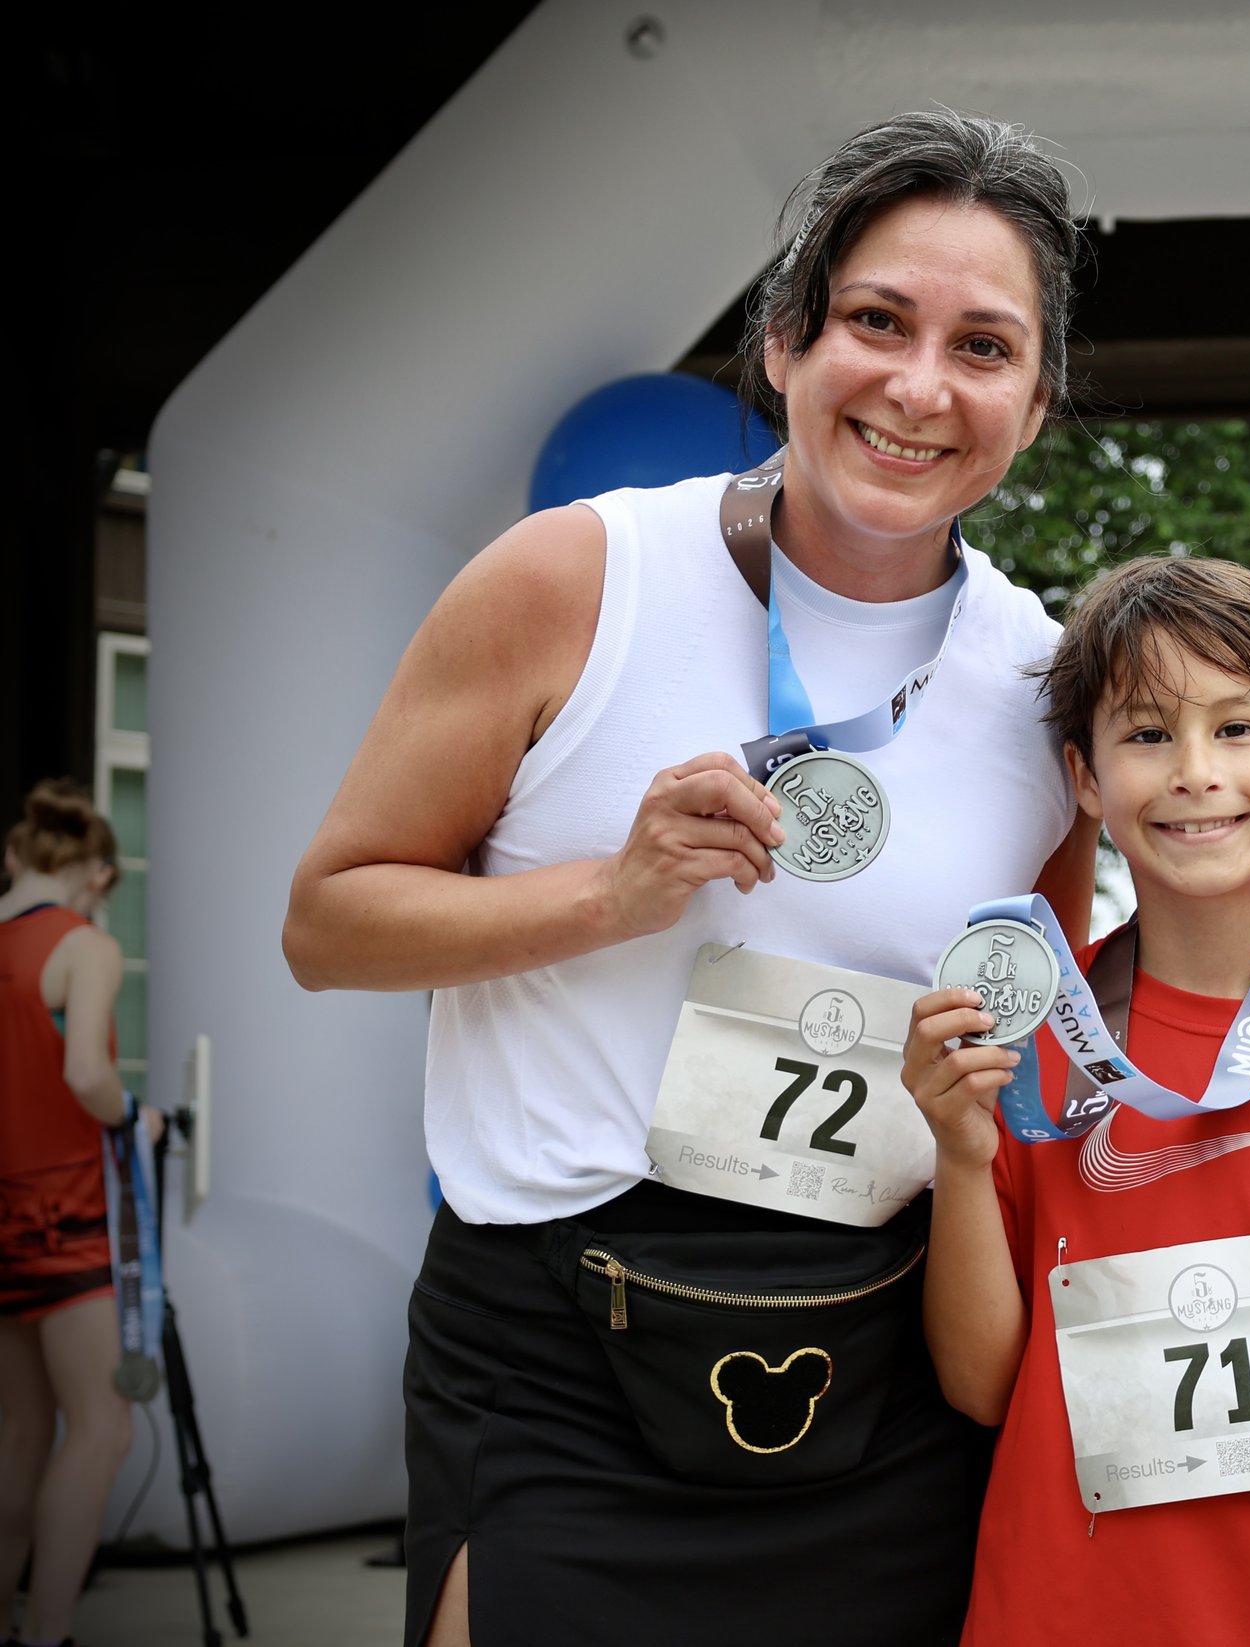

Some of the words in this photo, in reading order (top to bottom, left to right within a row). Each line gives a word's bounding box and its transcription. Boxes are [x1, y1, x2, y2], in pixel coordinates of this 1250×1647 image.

[727, 514, 764, 536] 2026
[793, 786, 879, 872] MUSTANG
[947, 981, 1042, 1017] STANG
[803, 1021, 856, 1043] MUSTANG
[760, 1057, 868, 1157] 72
[678, 1145, 750, 1176] Results
[1177, 1298, 1231, 1319] MUSTANG
[1105, 1457, 1176, 1482] Results
